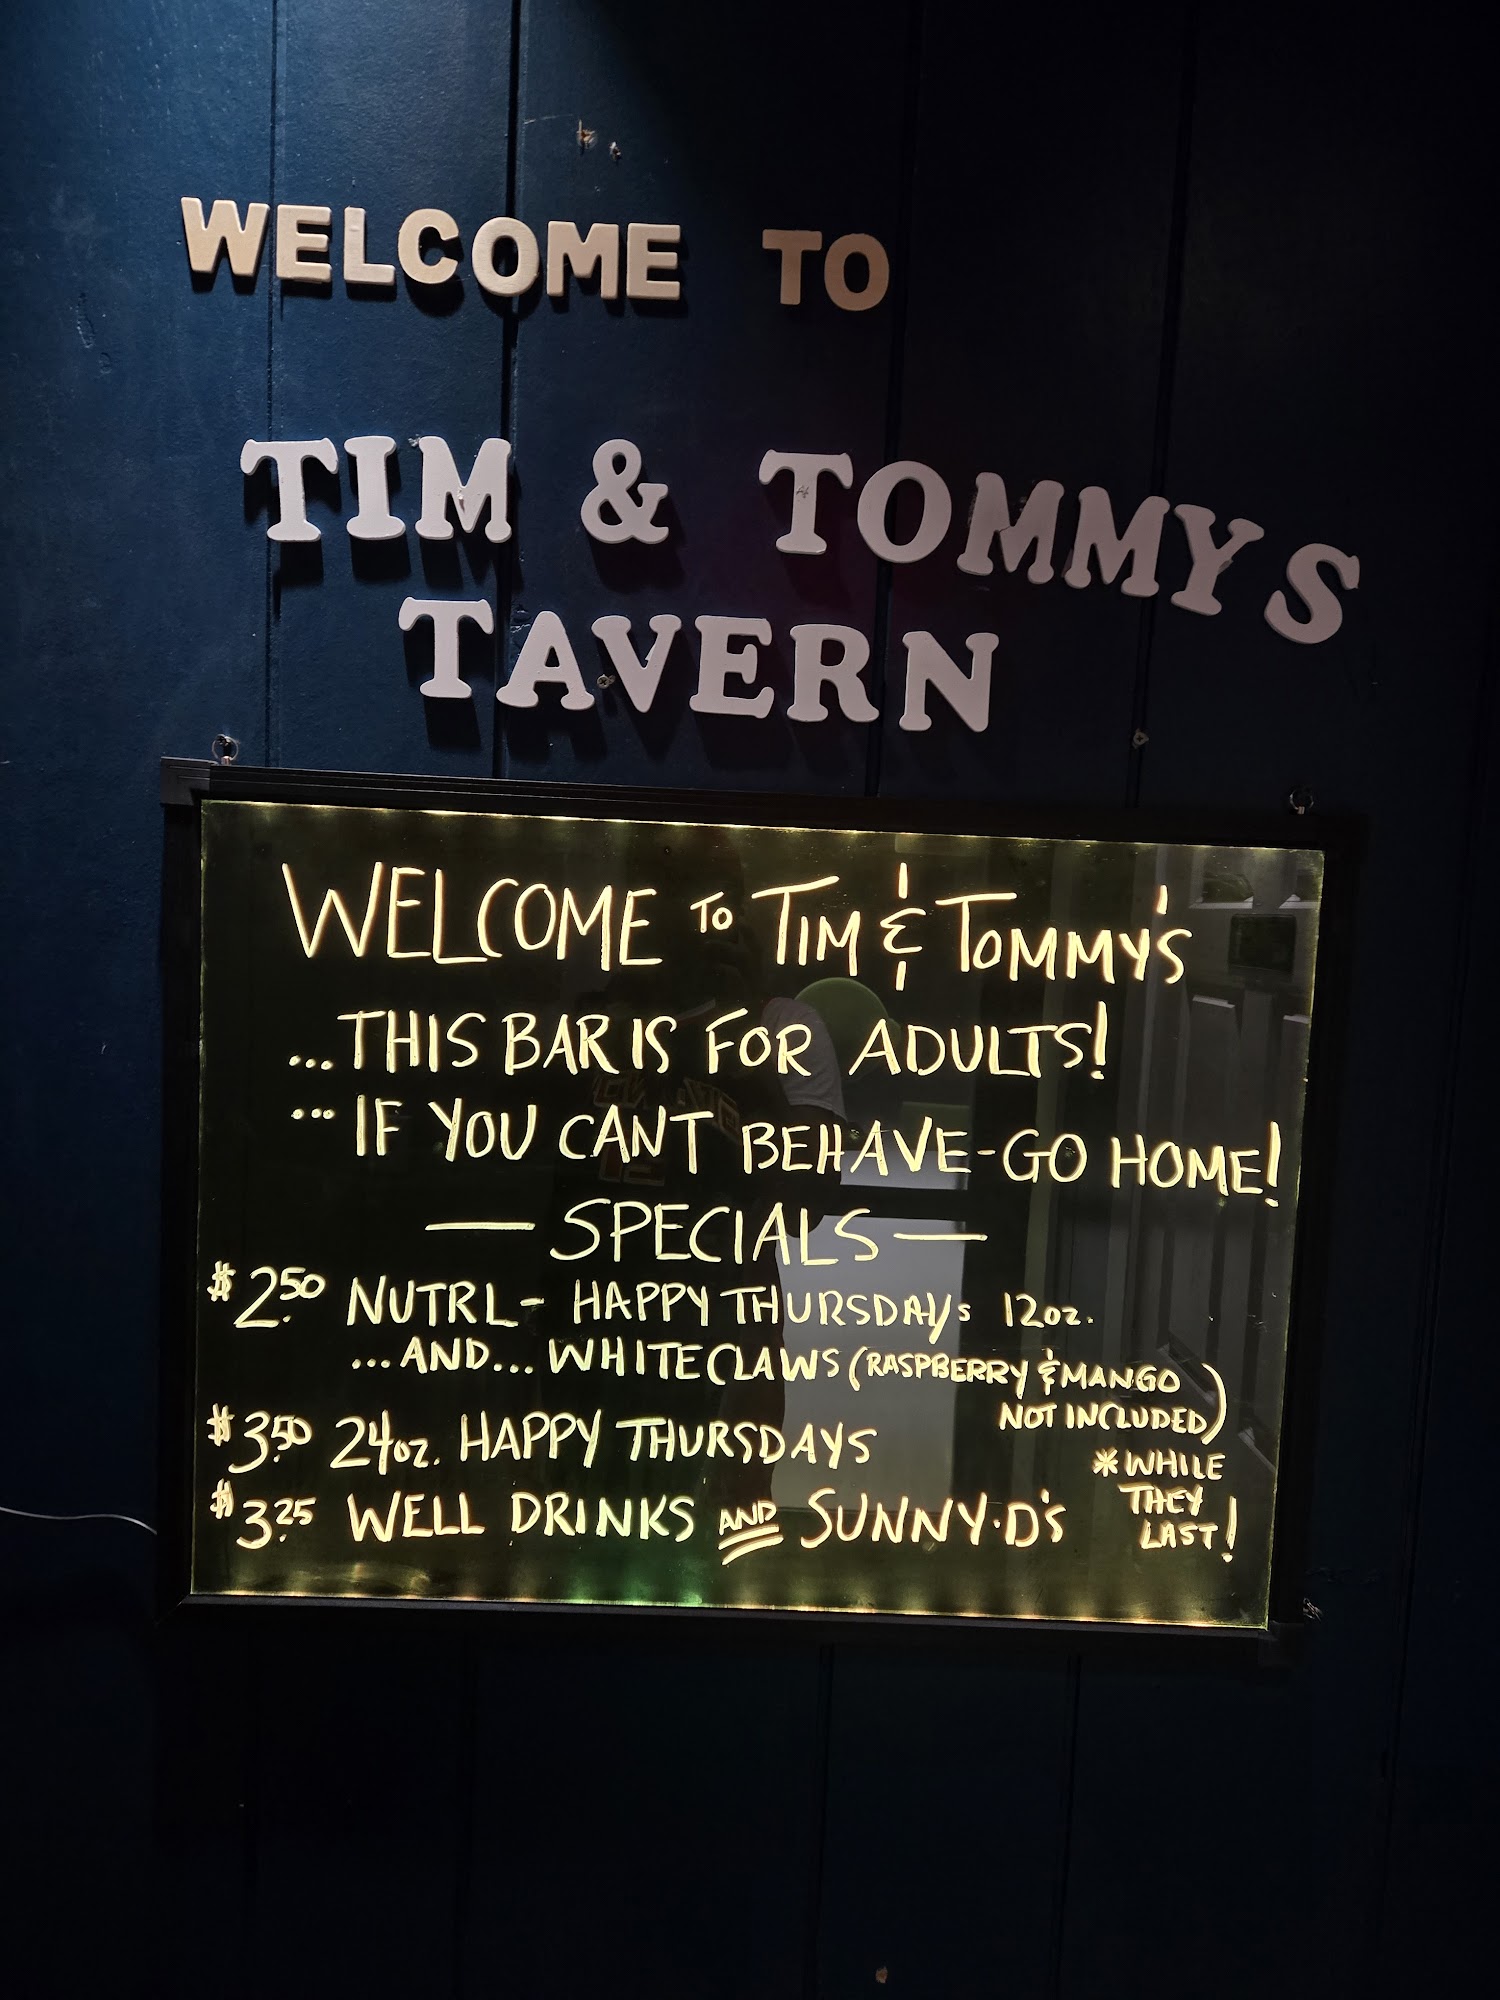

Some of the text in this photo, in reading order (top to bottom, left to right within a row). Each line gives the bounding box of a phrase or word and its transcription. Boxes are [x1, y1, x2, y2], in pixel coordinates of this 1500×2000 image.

[181, 197, 890, 312] WELCOME TO
[240, 435, 513, 545] TIM
[581, 438, 669, 545] &
[398, 597, 1000, 733] TAVERN
[281, 861, 663, 972] WELCOME
[751, 875, 861, 977] TIM
[879, 862, 927, 991] &
[500, 1012, 620, 1076] BAR
[632, 1015, 677, 1074] IS
[705, 1007, 812, 1077] FOR
[848, 1001, 1106, 1080] ADULTS!
[428, 1097, 538, 1162] YOU
[558, 1104, 714, 1175] CANT
[1111, 1121, 1281, 1208] HOME!
[549, 1198, 879, 1267] SPECIALS
[573, 1280, 709, 1327] HAPPY
[846, 1346, 1029, 1400] (RASPBERRY
[460, 1409, 602, 1468] HAPPY
[616, 1416, 878, 1470] THURSDAYS
[999, 1402, 1058, 1431] NOT
[346, 1490, 486, 1543] WELL
[510, 1492, 695, 1543] DRINKS
[718, 1500, 778, 1536] AND
[1117, 1484, 1204, 1517] THEY
